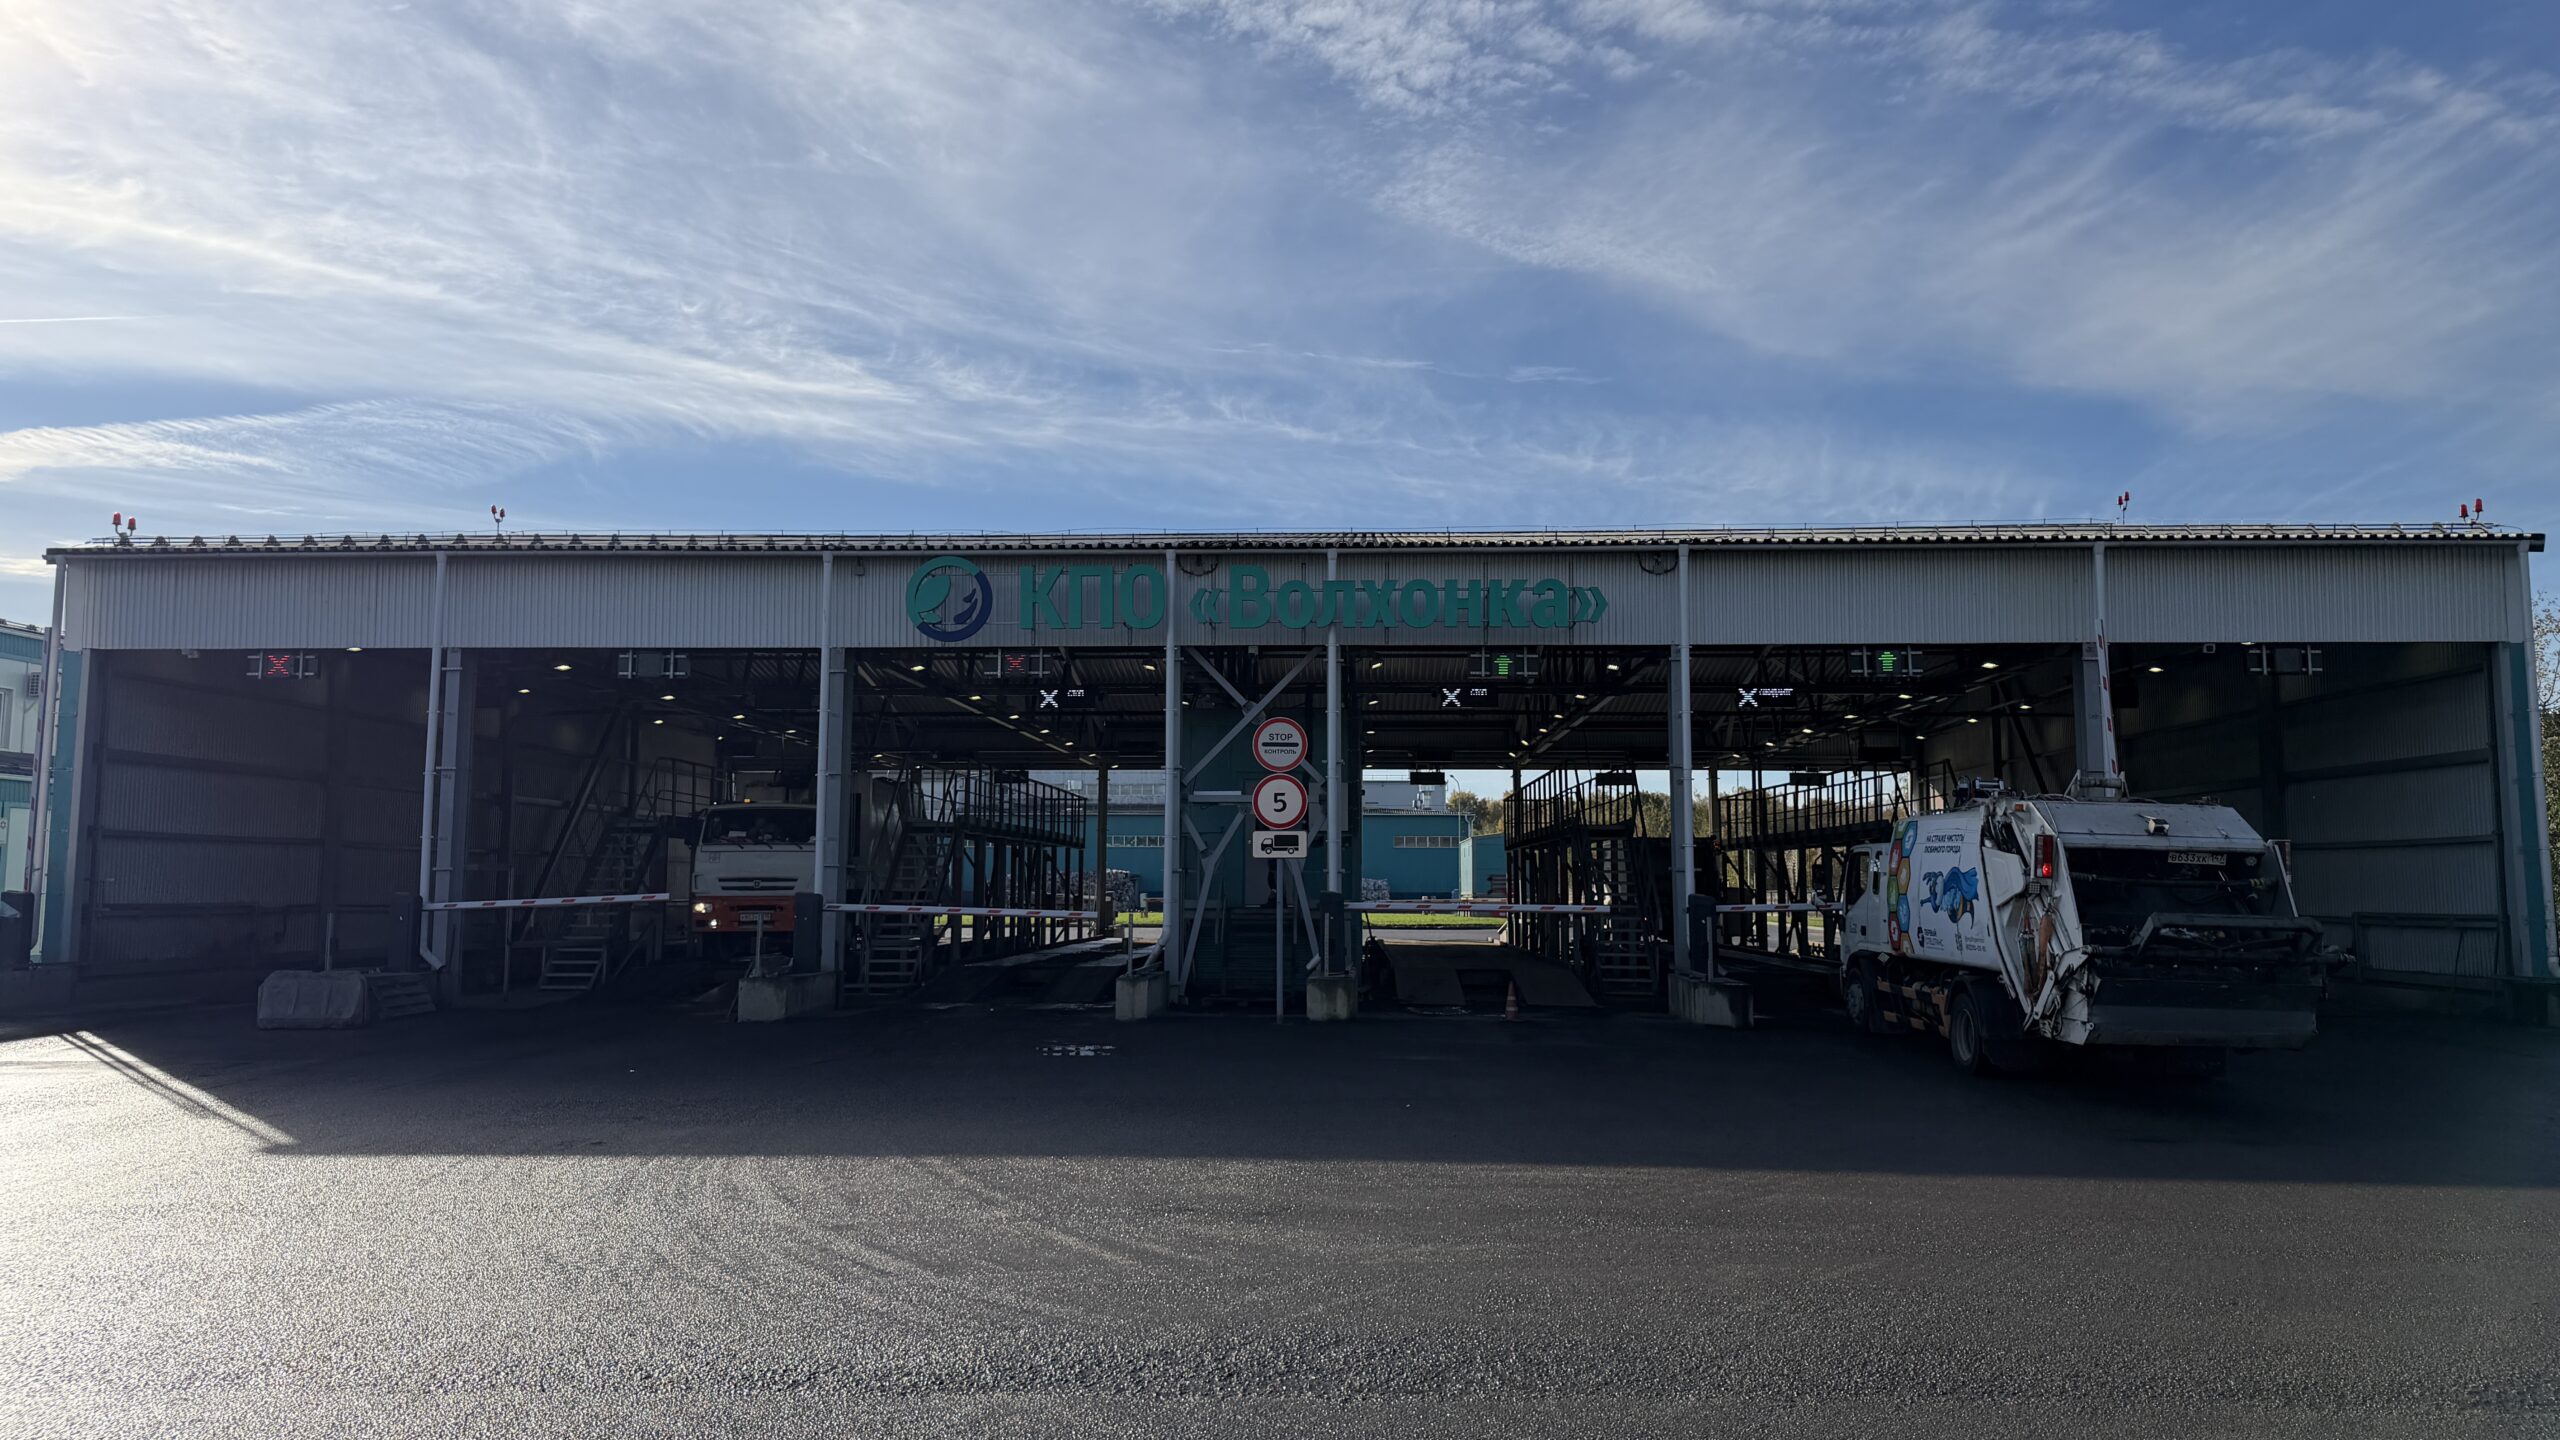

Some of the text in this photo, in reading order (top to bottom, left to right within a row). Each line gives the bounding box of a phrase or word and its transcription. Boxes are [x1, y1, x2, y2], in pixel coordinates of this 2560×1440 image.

[1019, 564, 1609, 630] КПО «Волхонка»
[1268, 733, 1293, 741] STOP
[1273, 792, 1287, 813] 5
